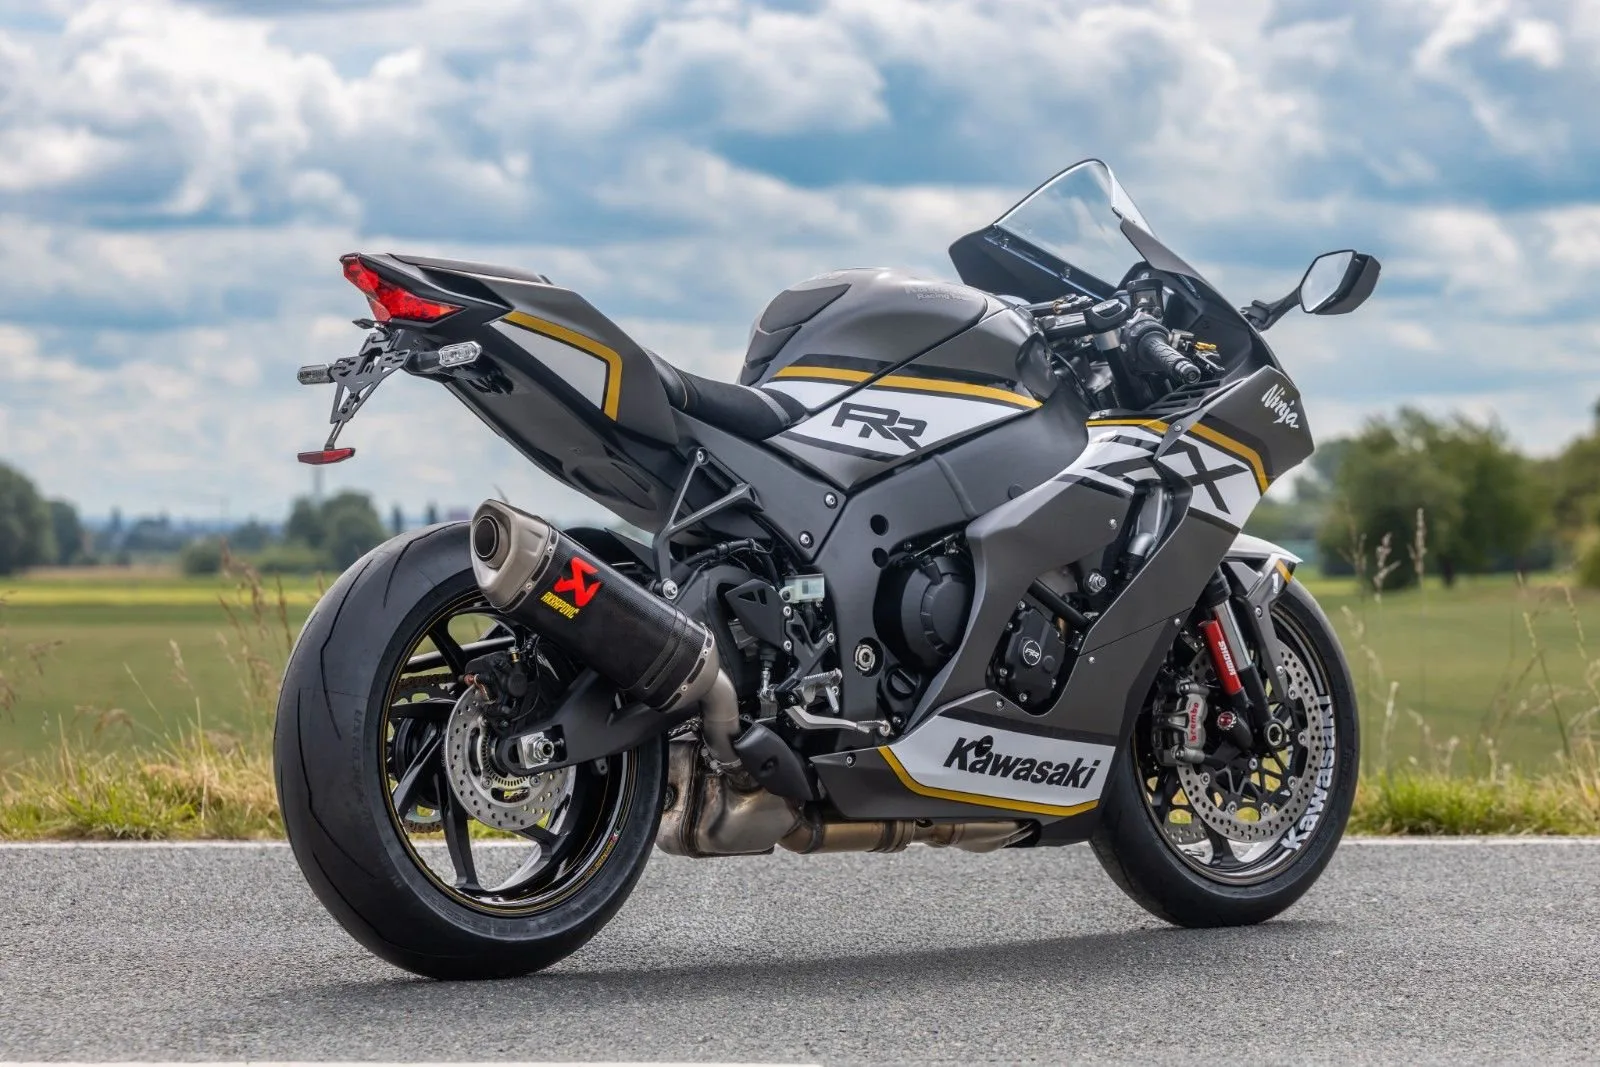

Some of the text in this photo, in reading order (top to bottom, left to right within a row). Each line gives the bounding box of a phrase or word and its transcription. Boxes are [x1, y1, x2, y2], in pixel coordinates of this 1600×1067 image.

[1262, 383, 1300, 429] Ninja
[1217, 640, 1237, 676] SHOWA
[1189, 702, 1200, 743] brembo
[943, 736, 1102, 789] Kawasaki
[1279, 695, 1336, 850] Kawasaki
